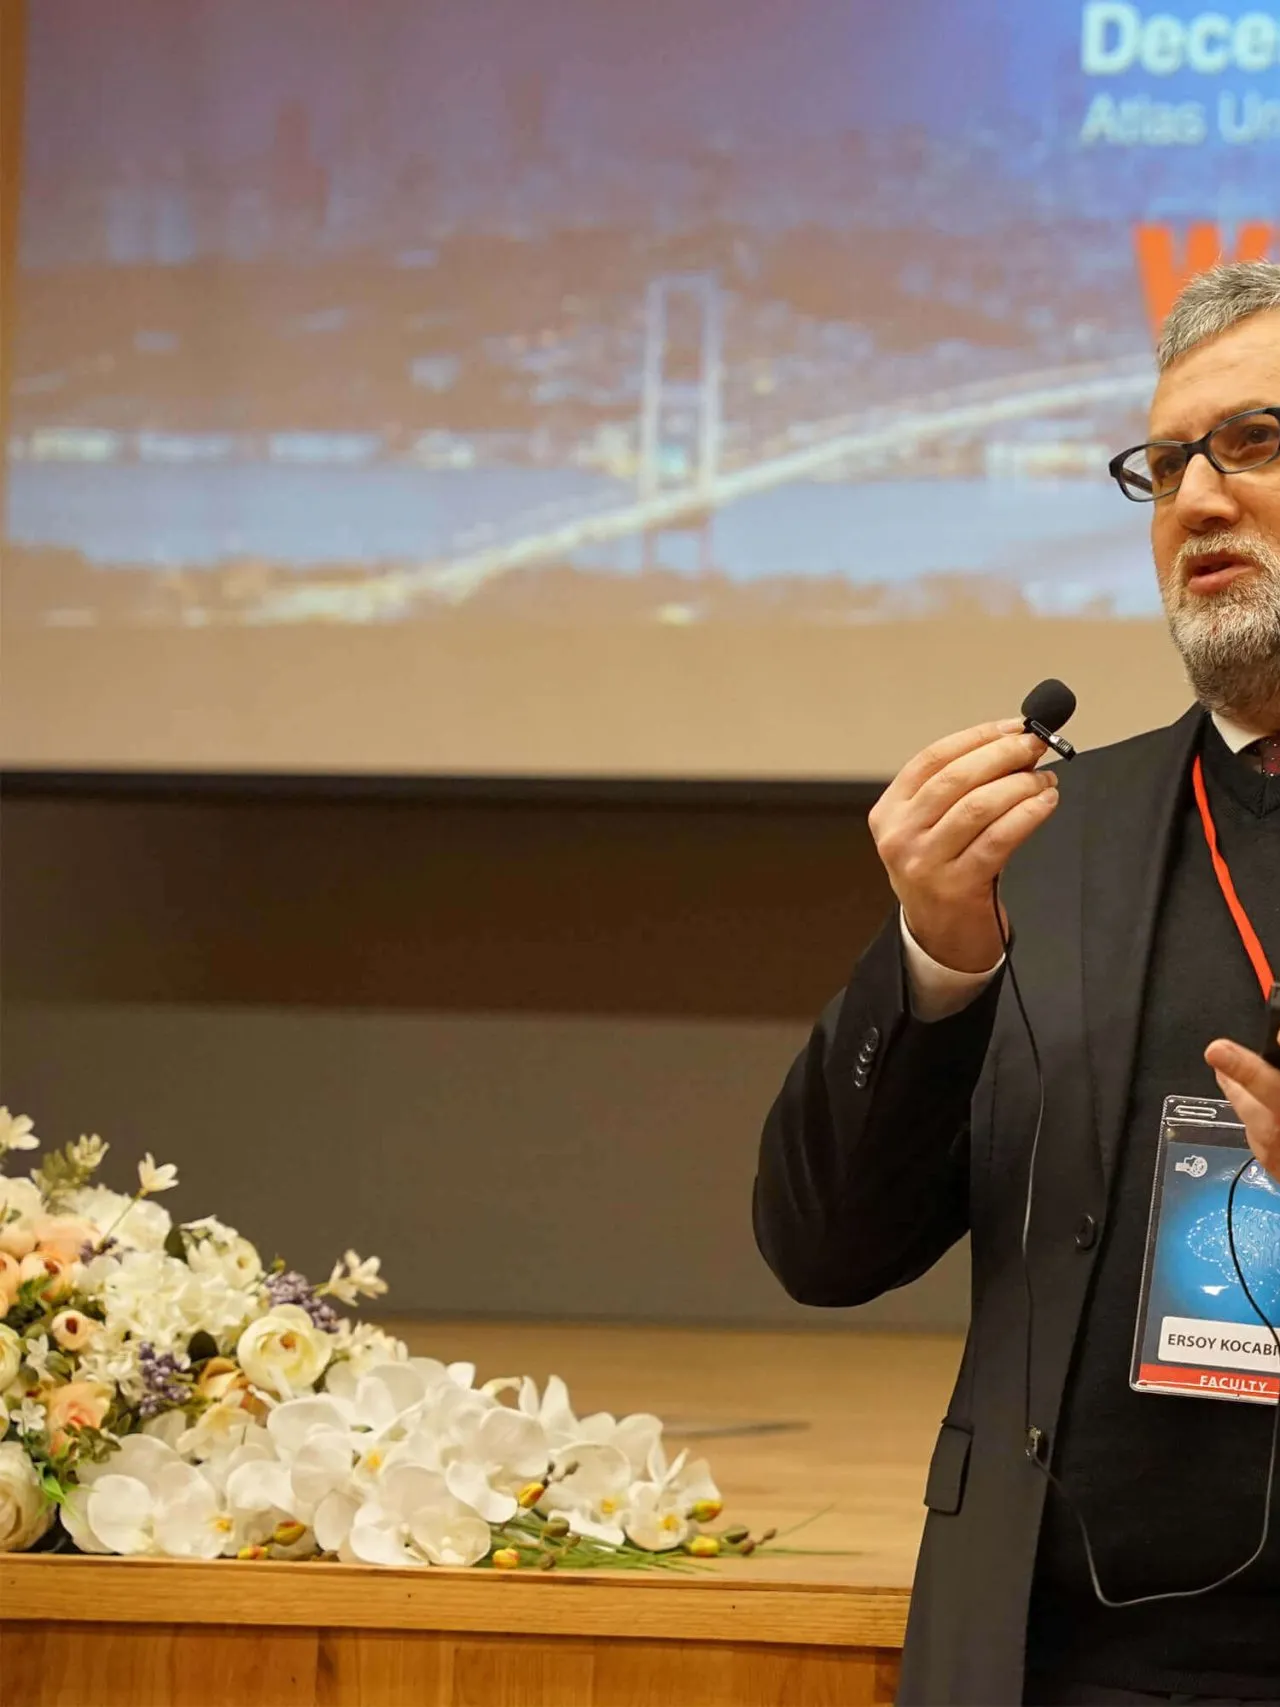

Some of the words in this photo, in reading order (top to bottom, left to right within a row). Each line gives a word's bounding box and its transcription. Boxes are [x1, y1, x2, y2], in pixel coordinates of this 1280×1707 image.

[1079, 94, 1206, 146] Atlas
[1167, 1333, 1217, 1349] ERSOY
[1199, 1375, 1269, 1393] FACULTY
